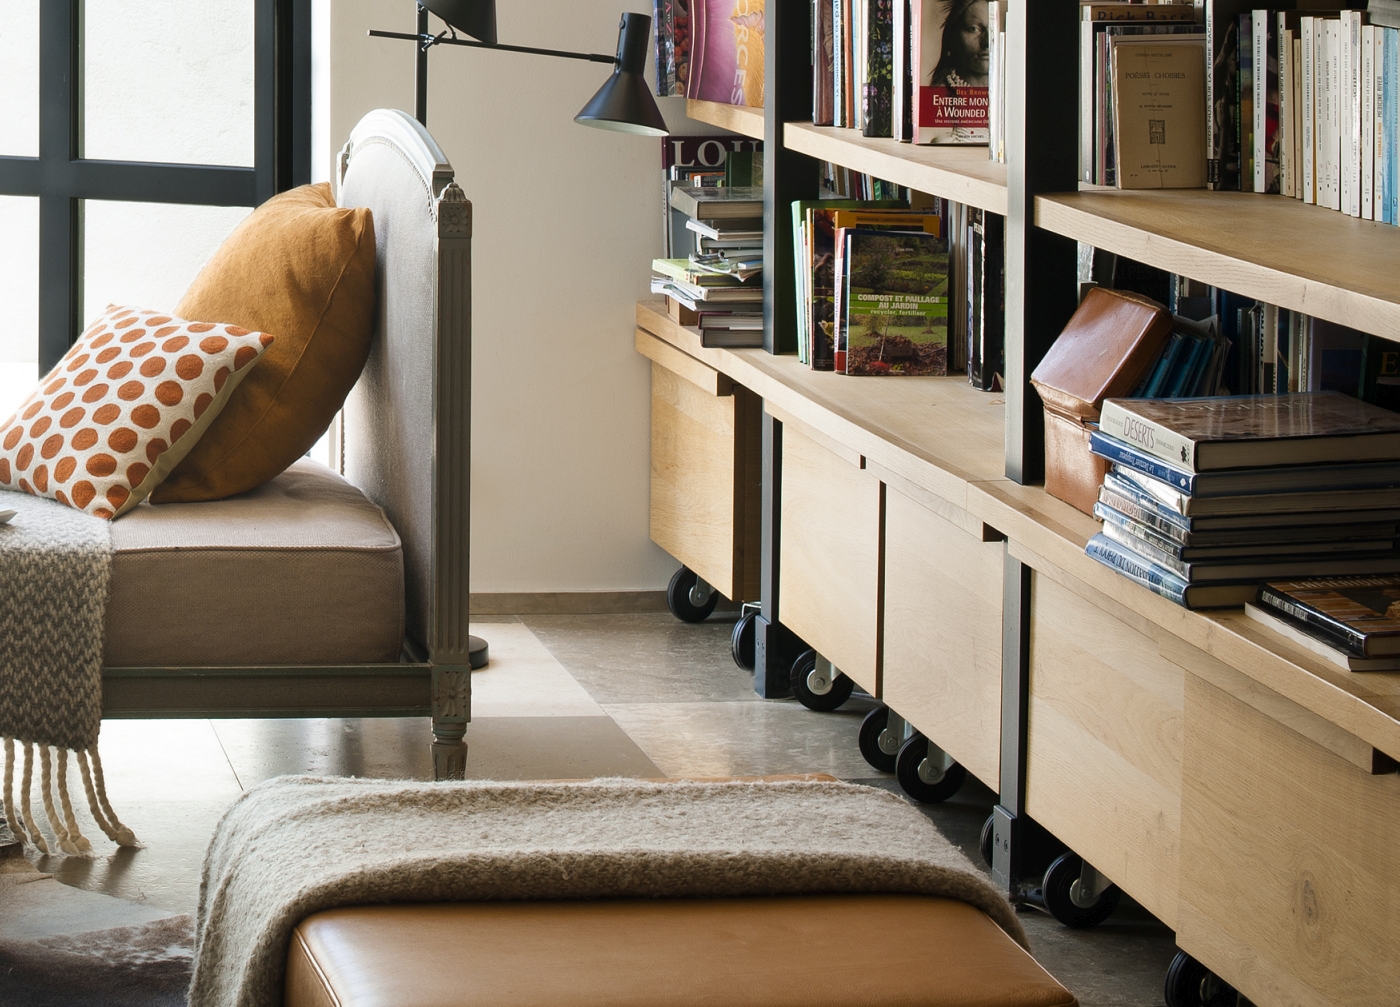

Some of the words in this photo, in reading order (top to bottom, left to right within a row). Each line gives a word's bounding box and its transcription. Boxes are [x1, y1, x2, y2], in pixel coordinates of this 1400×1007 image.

[664, 0, 673, 14] A
[1097, 9, 1137, 21] Rick
[1145, 9, 1188, 21] Bass
[664, 22, 673, 36] Z
[1125, 71, 1151, 80] POÉSIES
[932, 94, 968, 106] ENTERRE
[969, 97, 988, 107] MON
[936, 107, 943, 118] À
[943, 106, 986, 118] WOUNDED
[857, 294, 894, 302] COMPOST
[904, 296, 940, 304] PAILLAGE
[890, 302, 919, 310] JARDIN
[1123, 416, 1156, 450] DESERTS
